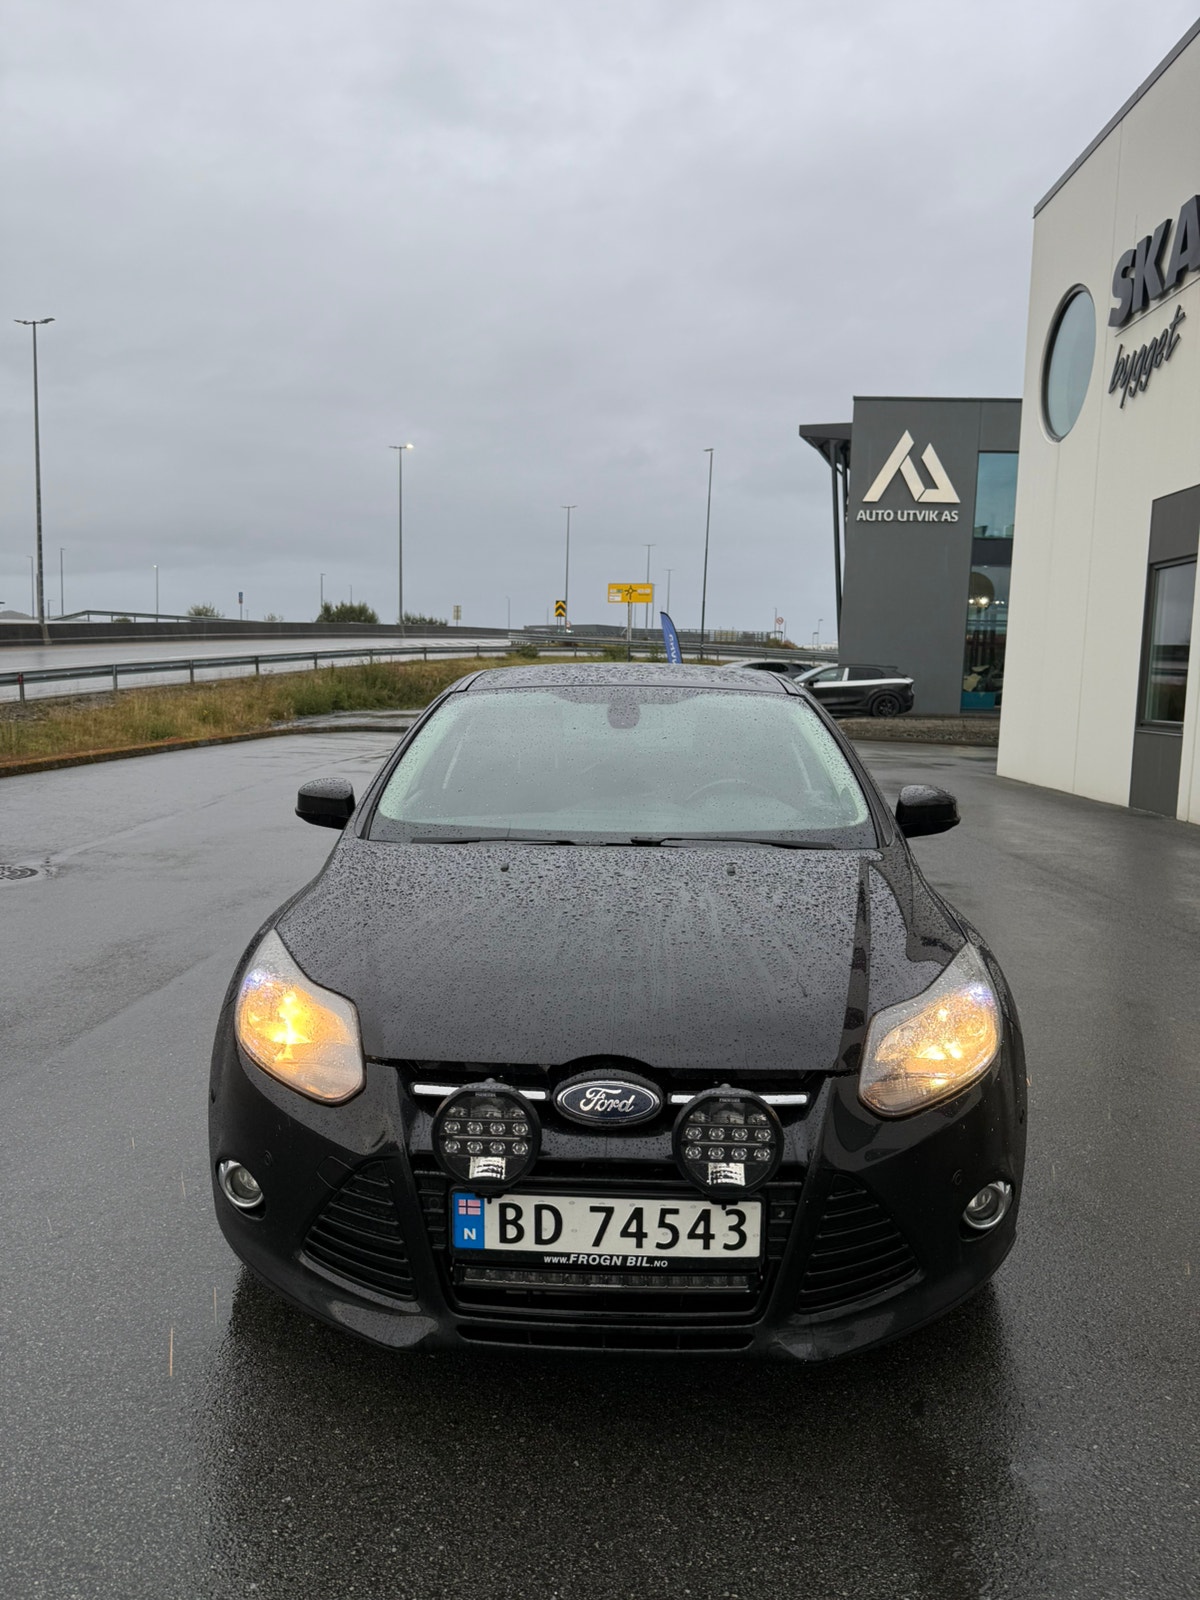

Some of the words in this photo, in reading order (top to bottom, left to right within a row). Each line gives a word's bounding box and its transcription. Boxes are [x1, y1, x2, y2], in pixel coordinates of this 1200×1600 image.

[1108, 195, 1200, 327] SKA
[1108, 304, 1186, 409] bygget
[856, 509, 894, 522] AUTO
[897, 510, 939, 522] UTVIK
[941, 510, 959, 522] AS
[580, 1087, 635, 1112] Ford
[463, 1228, 476, 1240] N
[498, 1202, 563, 1246] BD
[589, 1205, 748, 1251] 74543
